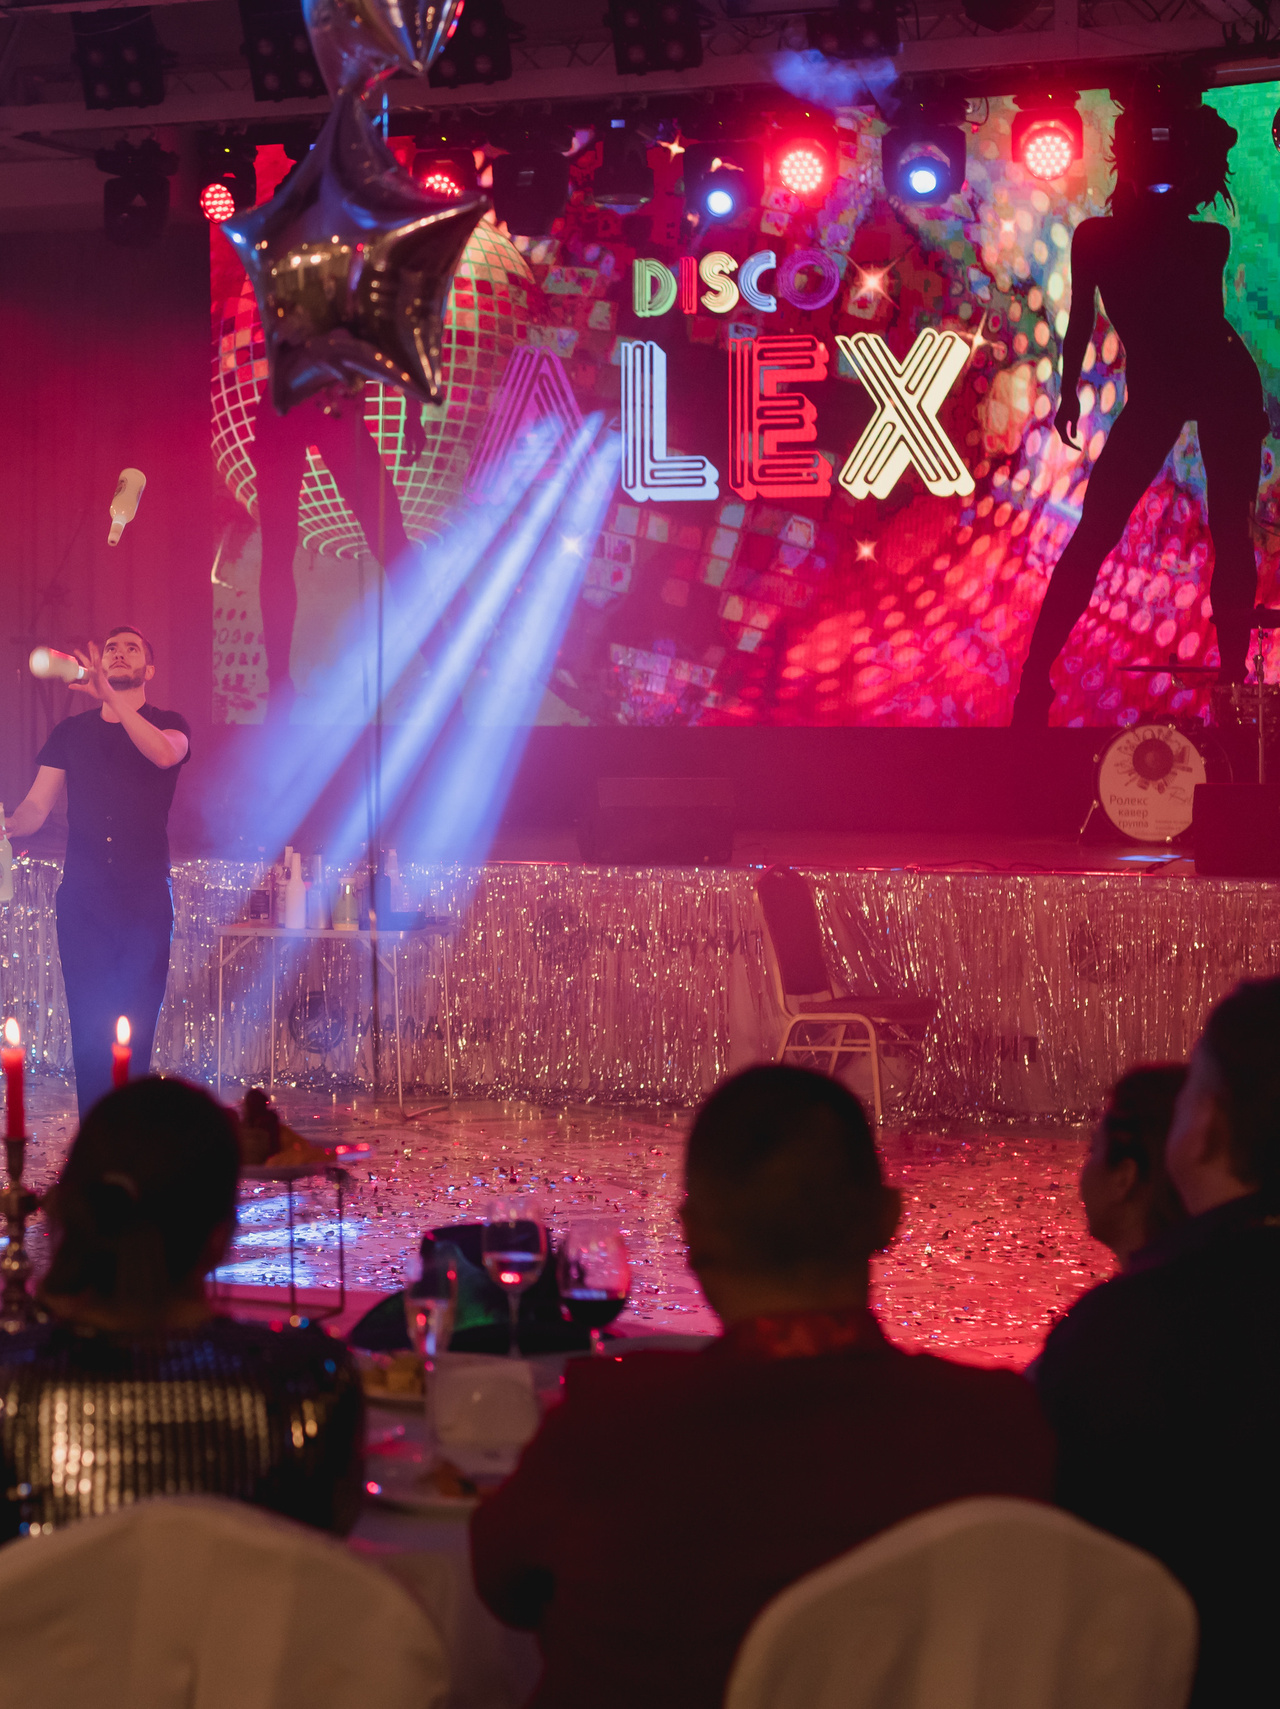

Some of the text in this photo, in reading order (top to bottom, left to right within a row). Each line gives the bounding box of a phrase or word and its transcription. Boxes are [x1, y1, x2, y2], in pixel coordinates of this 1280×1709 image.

[633, 249, 840, 318] DISCO
[463, 327, 976, 503] ALEX
[1109, 794, 1149, 806] Ролекс
[1118, 808, 1149, 819] кавер
[1118, 820, 1149, 829] группа
